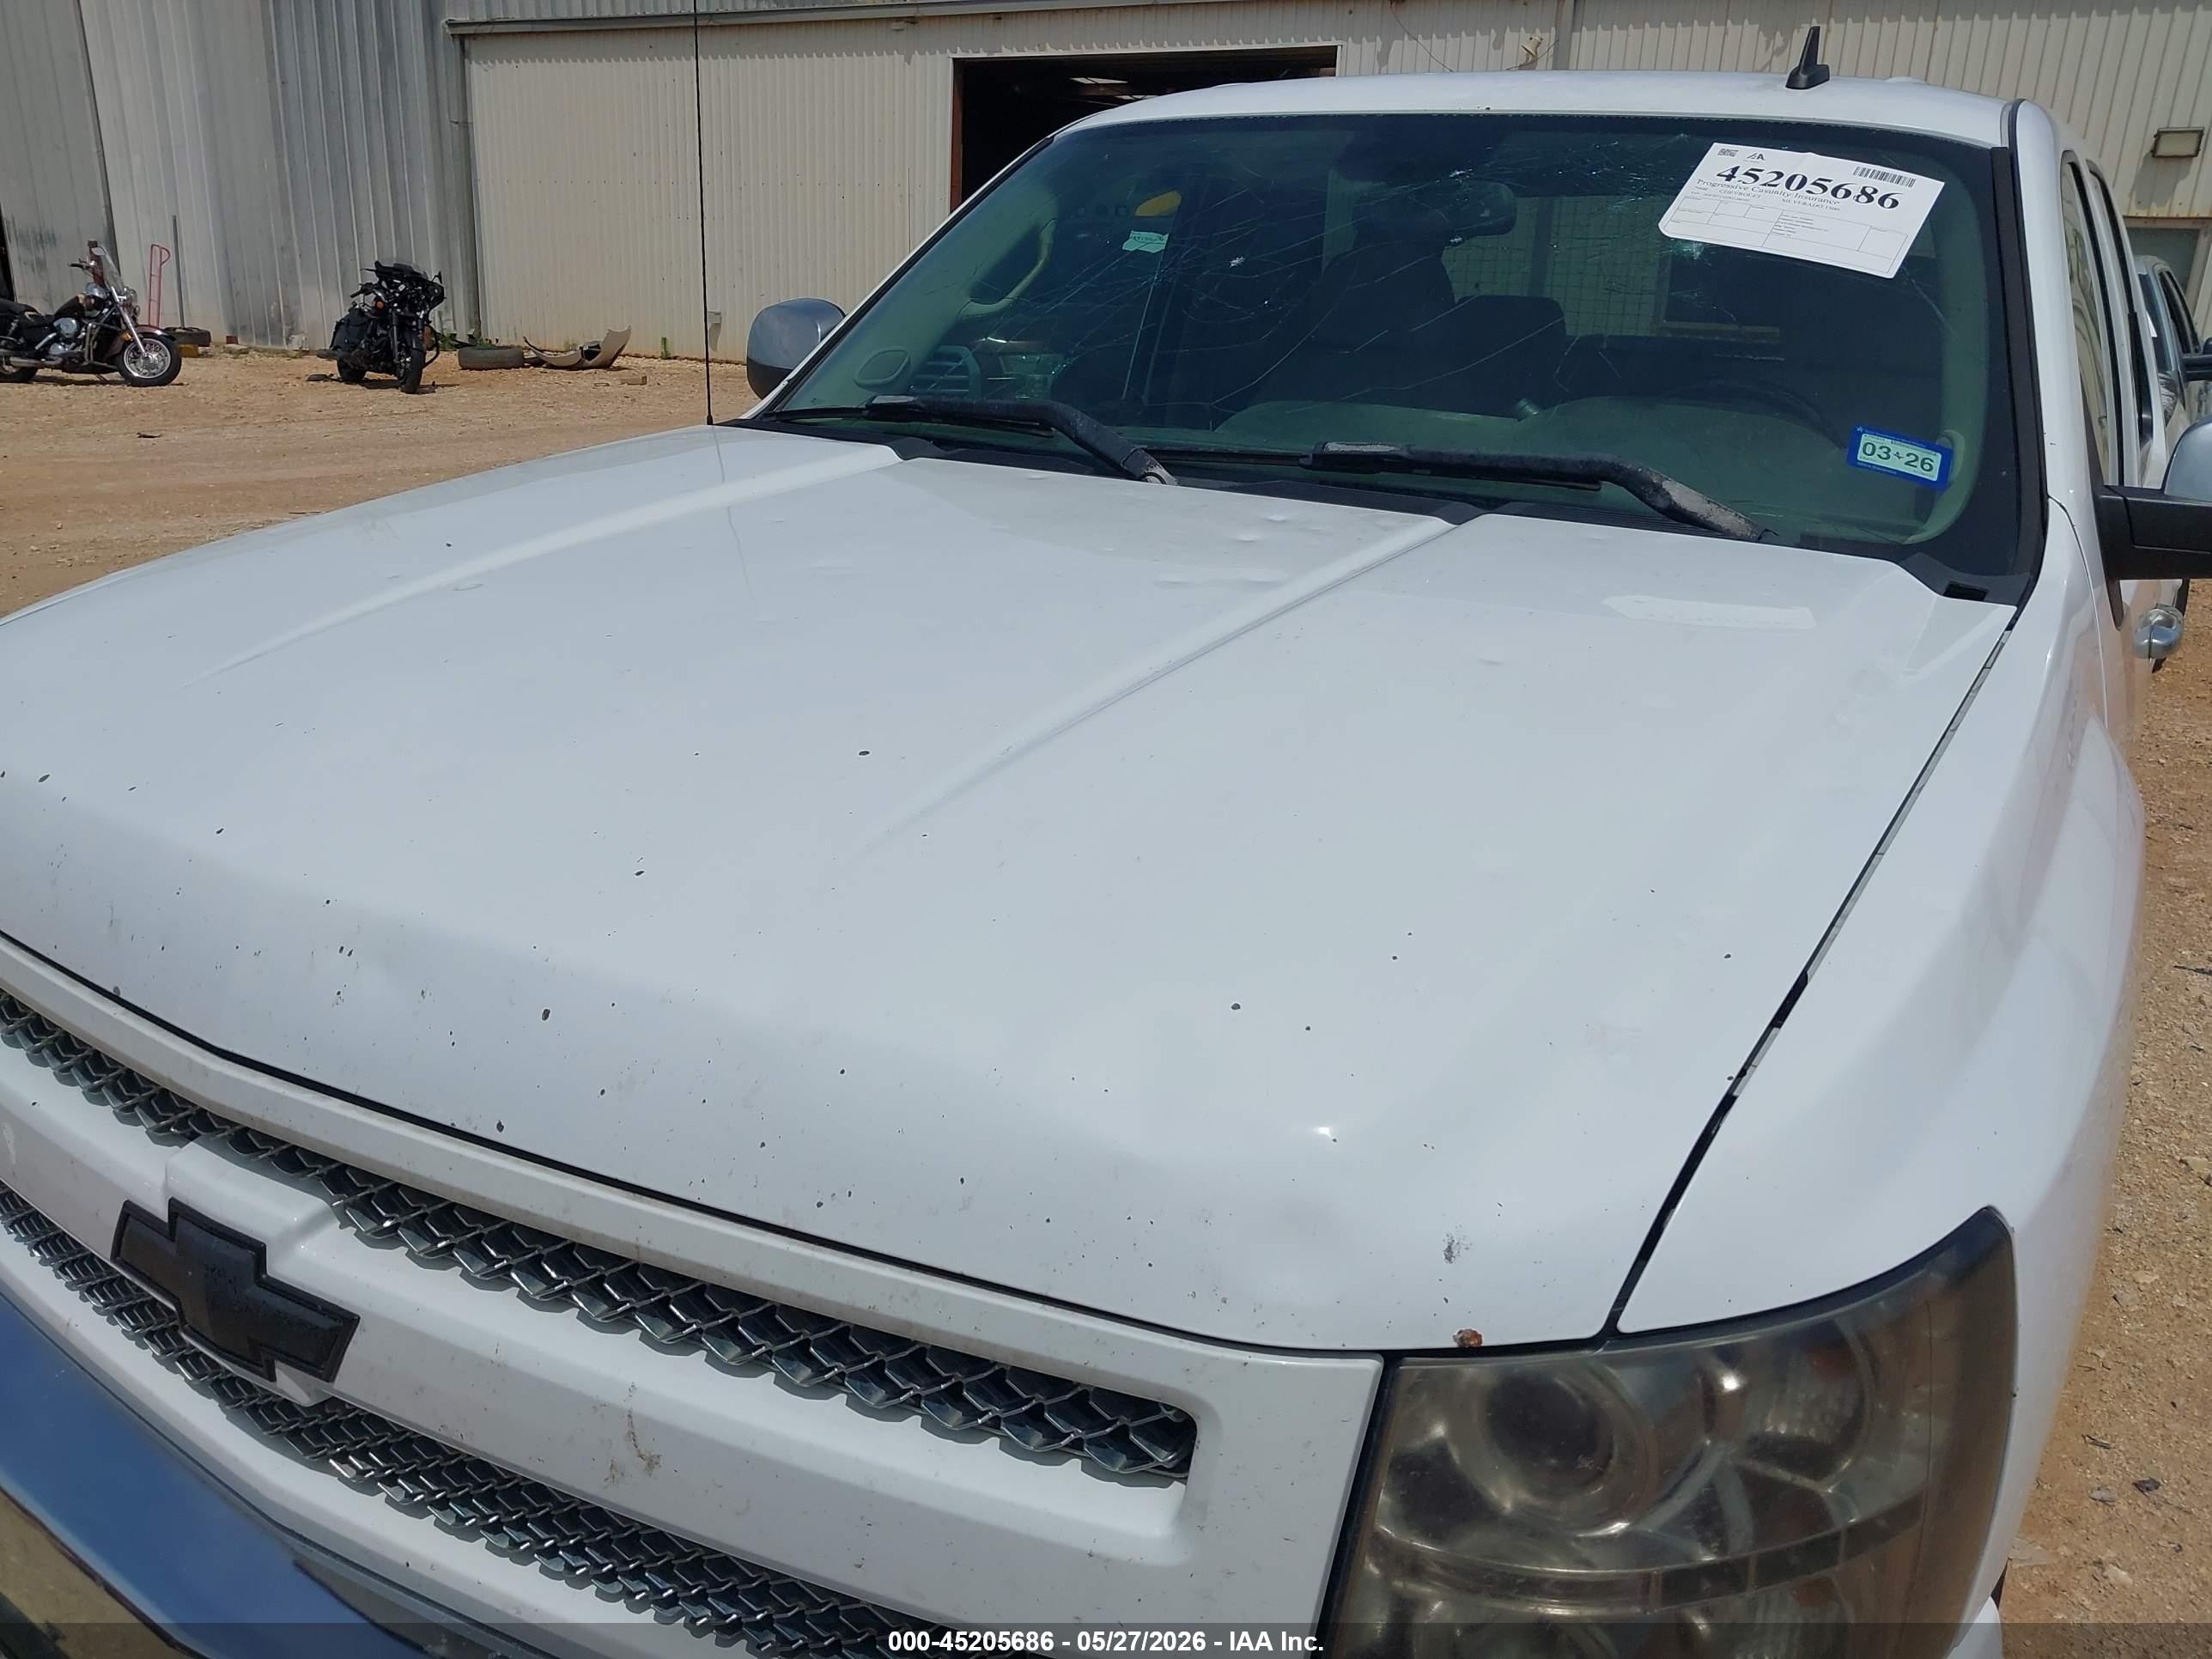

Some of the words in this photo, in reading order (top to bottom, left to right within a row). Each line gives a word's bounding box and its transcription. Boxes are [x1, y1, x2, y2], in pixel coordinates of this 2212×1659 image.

[1697, 179, 1751, 192] Progressive
[1751, 185, 1796, 198] Casualty
[1794, 192, 1841, 205] Insurance
[1716, 165, 1905, 210] 45205686
[1862, 441, 1892, 460] 03
[1904, 452, 1935, 472] 26
